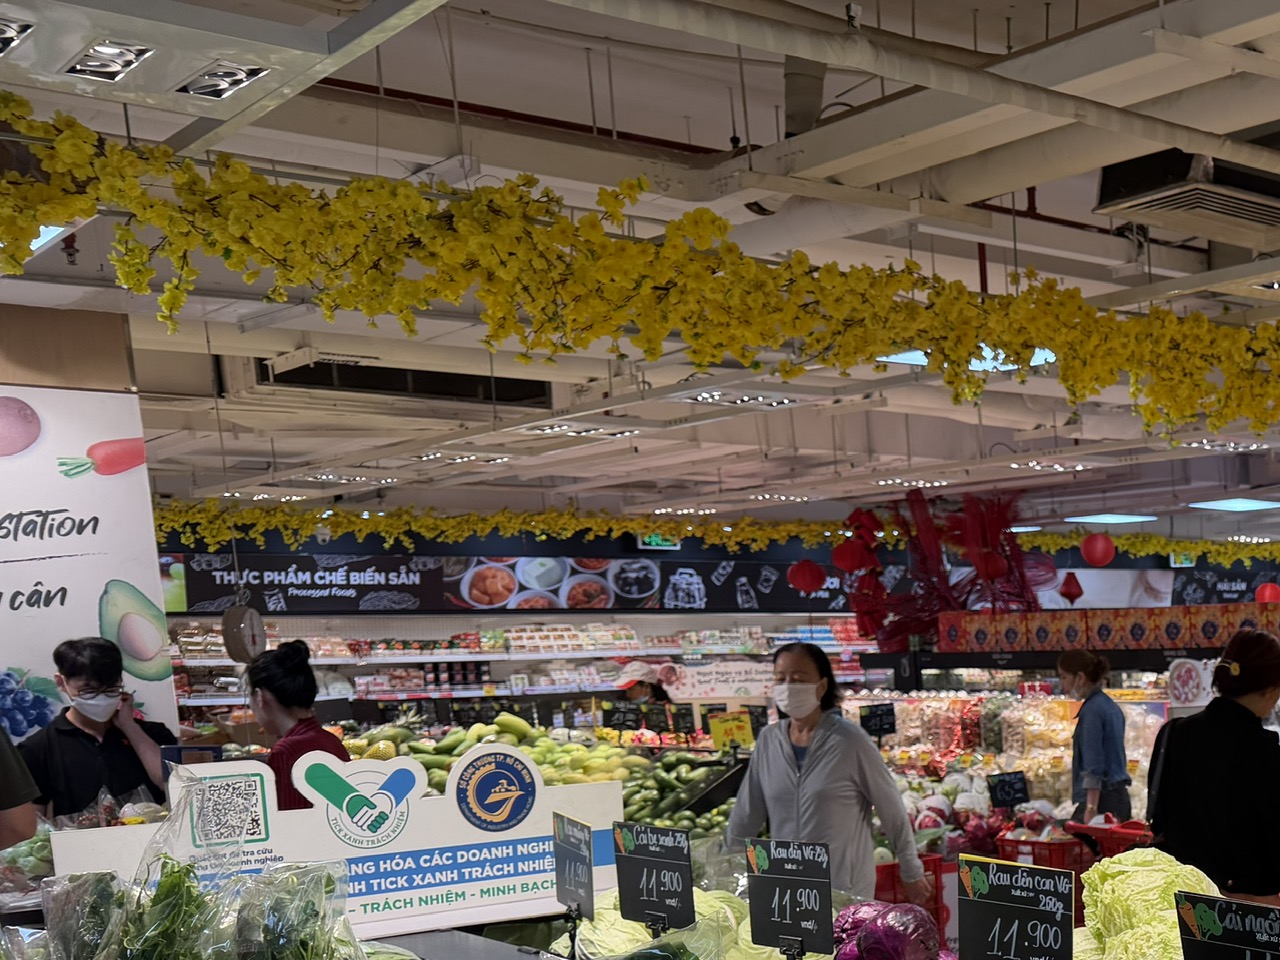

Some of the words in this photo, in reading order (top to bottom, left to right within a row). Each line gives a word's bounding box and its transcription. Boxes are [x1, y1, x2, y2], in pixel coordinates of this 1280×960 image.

[314, 566, 348, 585] CHẾ
[350, 566, 386, 585] BIẾN
[9, 581, 67, 611] cân
[370, 875, 409, 891] TICK
[412, 870, 459, 886] XANH
[461, 862, 515, 882] TRÁCH
[517, 856, 556, 876] NHIỆ
[379, 856, 416, 873] HÓA
[418, 851, 454, 869] CÁC
[457, 846, 513, 865] DOANH
[988, 863, 1010, 886] Rau
[360, 896, 413, 915] TRÁCH
[418, 891, 466, 906] NHIỆM
[480, 884, 517, 900] MINH
[639, 868, 683, 902] 11.900
[771, 887, 820, 924] 11.900
[987, 917, 1062, 960] 11.900
